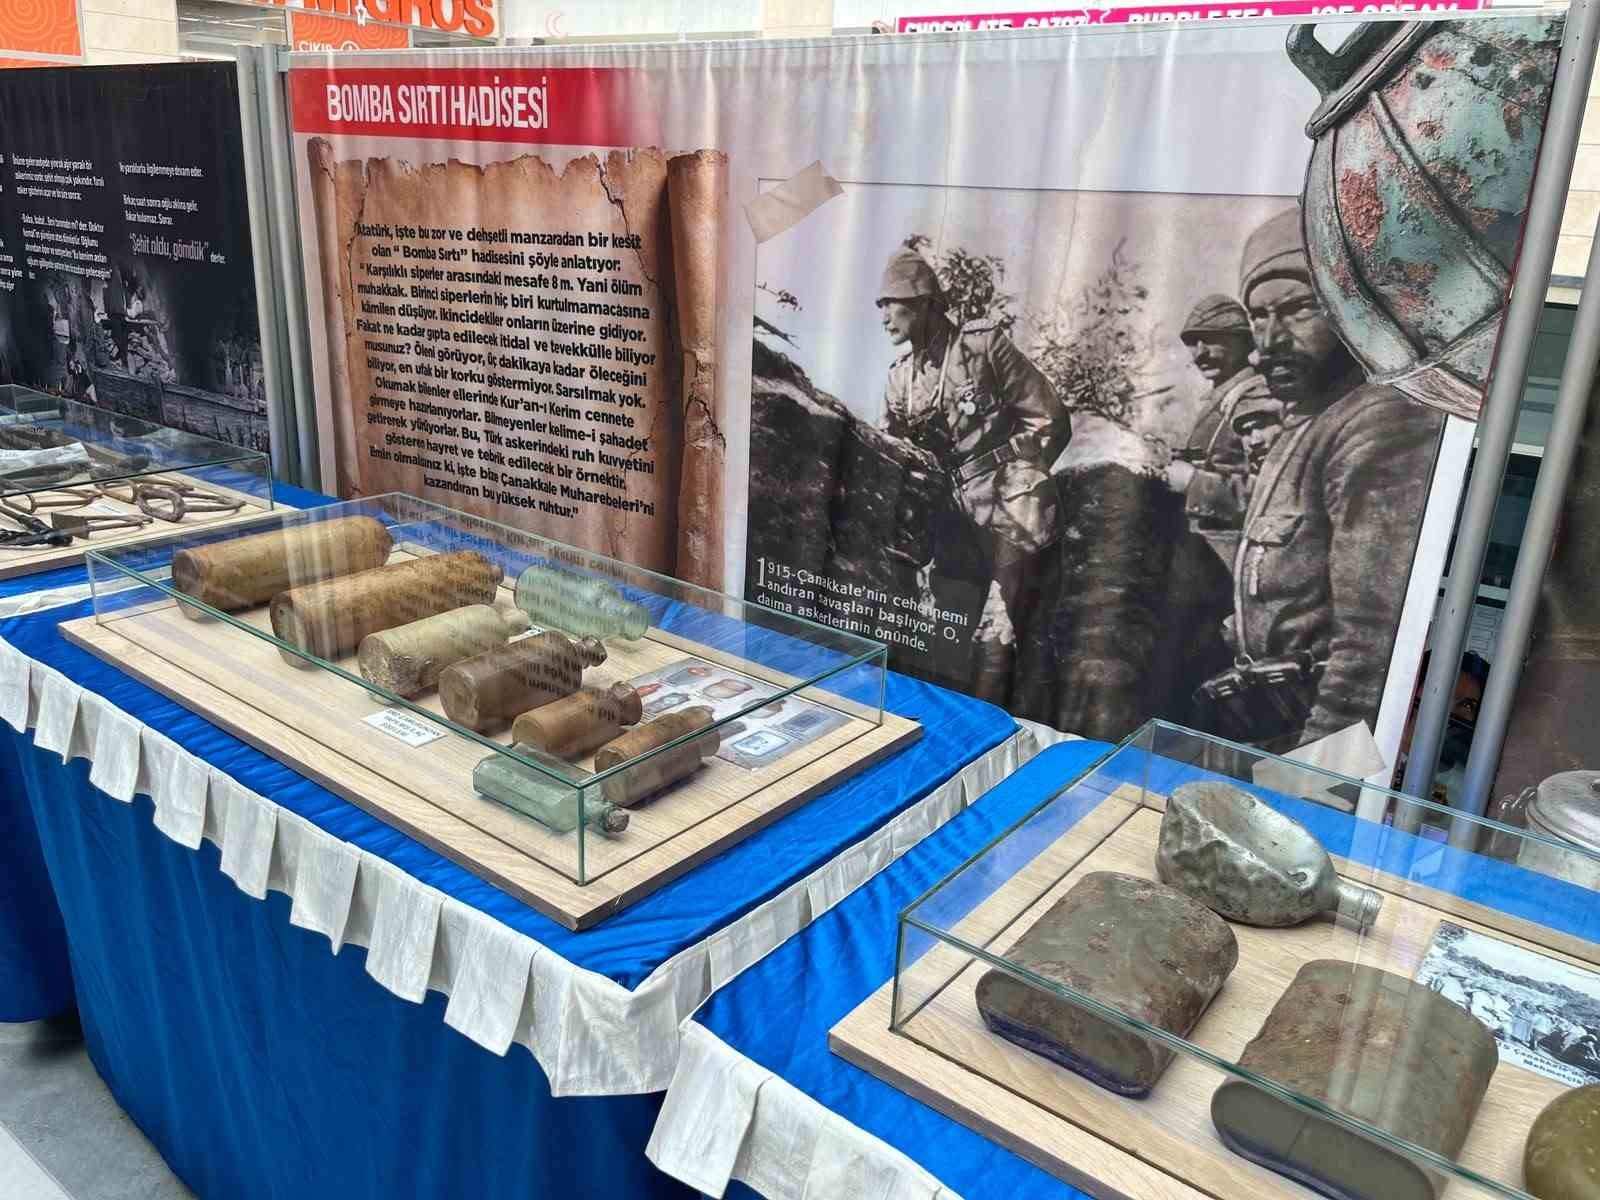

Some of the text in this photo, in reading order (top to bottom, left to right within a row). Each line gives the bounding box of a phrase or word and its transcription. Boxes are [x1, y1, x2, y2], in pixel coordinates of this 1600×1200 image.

[326, 76, 548, 129] BOMBA SIRTI HADİSESİ
[151, 236, 171, 258] oldu,
[395, 224, 416, 240] işte
[418, 225, 429, 238] bu
[431, 228, 446, 240] zor
[449, 229, 463, 241] ve
[467, 227, 508, 244] dehşetli
[511, 231, 584, 247] manzaradan
[588, 232, 609, 247] bir
[371, 244, 391, 257] olan
[402, 245, 437, 260] Bomba
[472, 249, 525, 265] hadisesini
[528, 252, 559, 270] şöyle
[561, 254, 621, 273] anlatıyor:
[411, 265, 444, 281] siperler
[447, 269, 502, 286] arasındaki
[504, 274, 549, 289] mesafe
[552, 275, 559, 290] 8
[560, 279, 574, 291] m.
[577, 277, 608, 293] Yani
[611, 279, 643, 296] ölüm
[411, 285, 439, 300] Birinci
[440, 288, 493, 305] siperlerin
[494, 291, 508, 309] hiç
[511, 294, 533, 309] biri
[537, 296, 650, 319] kurtulmamacasına
[398, 304, 438, 321] düşüyor.
[506, 315, 549, 331] onların
[552, 319, 595, 336] üzerine
[600, 324, 647, 342] gidiyor.
[364, 340, 411, 355] musunuz?
[438, 347, 486, 367] görüyor,
[488, 352, 497, 369] üç
[499, 353, 551, 374] dakikaya
[553, 360, 585, 378] kadar
[589, 366, 647, 387] öleceğini
[383, 324, 394, 335] ne
[397, 323, 425, 338] kadar
[427, 328, 451, 343] gıpta
[453, 330, 498, 347] edilecek
[534, 340, 548, 352] ve
[551, 340, 612, 360] tevekkülle
[615, 347, 656, 366] biliyor
[375, 376, 416, 393] Okumak
[418, 381, 451, 399] bilenler
[453, 387, 499, 406] ellerinde
[550, 402, 581, 420] Kerim
[585, 409, 634, 428] cennete
[399, 363, 413, 374] en
[434, 365, 449, 379] bir
[451, 367, 485, 385] korku
[488, 373, 554, 395] göstermiyor.
[556, 383, 616, 402] Sarsılmak
[619, 392, 647, 409] yok.
[367, 412, 408, 429] getirerek
[461, 427, 481, 443] Bu,
[483, 429, 503, 446] Türk
[505, 436, 569, 459] askerindeki
[572, 449, 594, 462] ruh
[599, 450, 655, 474] kuvvetini
[485, 411, 547, 434] Bilmeyenler
[549, 421, 596, 442] kelime-i
[600, 431, 649, 450] şahadet
[369, 445, 392, 459] Emin
[457, 462, 477, 478] işte
[501, 472, 557, 496] Çanakkale
[426, 438, 459, 456] hayret
[461, 446, 474, 459] ve
[478, 448, 505, 466] tebrik
[508, 455, 555, 475] edilecek
[557, 463, 573, 479] bir
[423, 474, 479, 497] kazandıran
[496, 488, 536, 510] yüksek
[757, 592, 928, 652] daima askerlerinin önünde.
[767, 581, 815, 600] andıran
[879, 608, 936, 636] başlıyor.
[943, 626, 960, 644] O,
[893, 596, 968, 626] cehennemi
